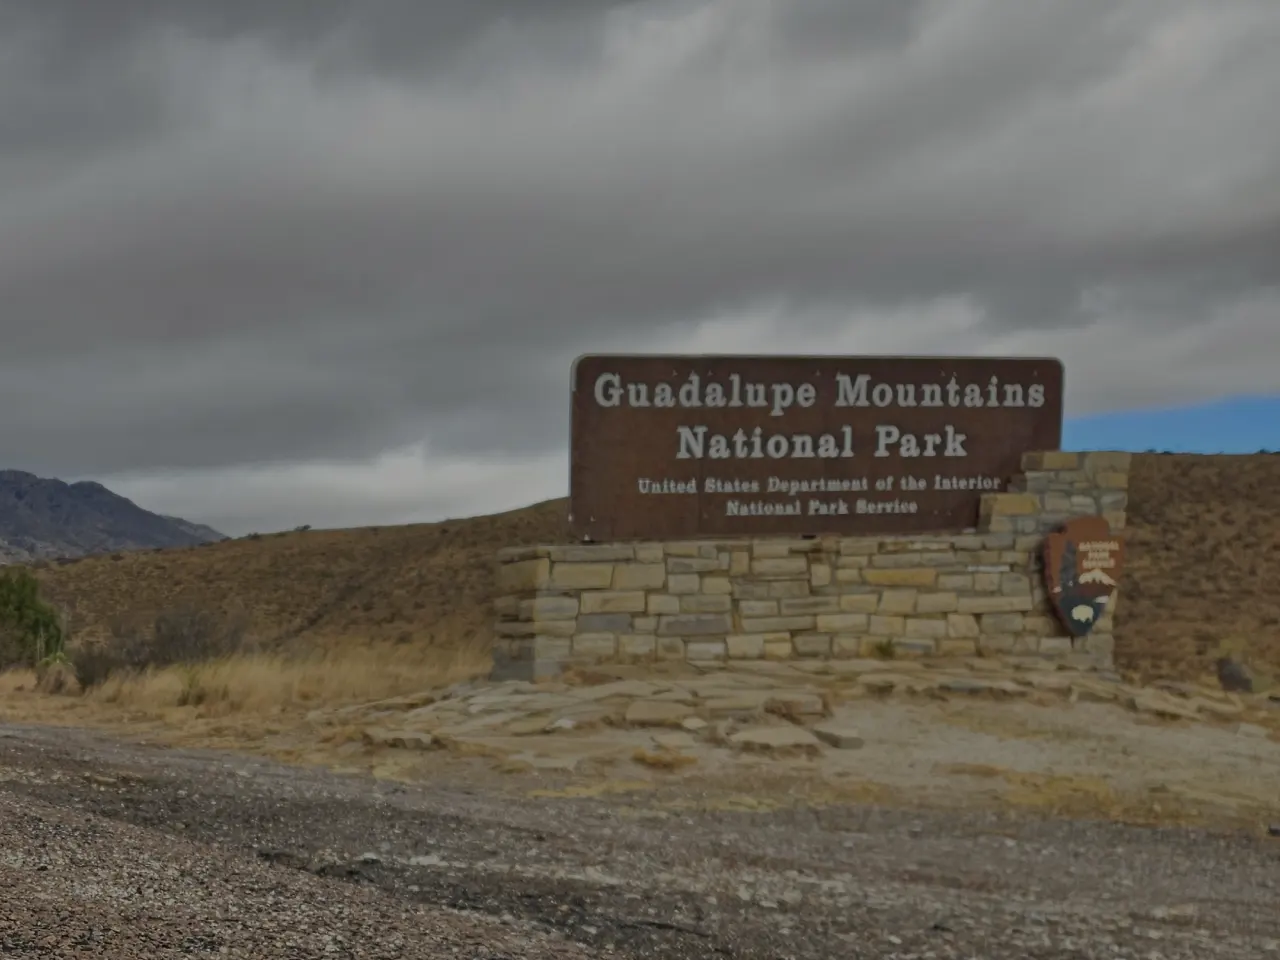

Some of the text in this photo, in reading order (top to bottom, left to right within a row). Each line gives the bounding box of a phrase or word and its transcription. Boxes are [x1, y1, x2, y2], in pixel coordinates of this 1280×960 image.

[594, 372, 1045, 416] Guadalupe Mountains
[676, 425, 968, 459] National Park
[638, 474, 1002, 496] United States Department of the Interior
[726, 498, 918, 516] National Park Service
